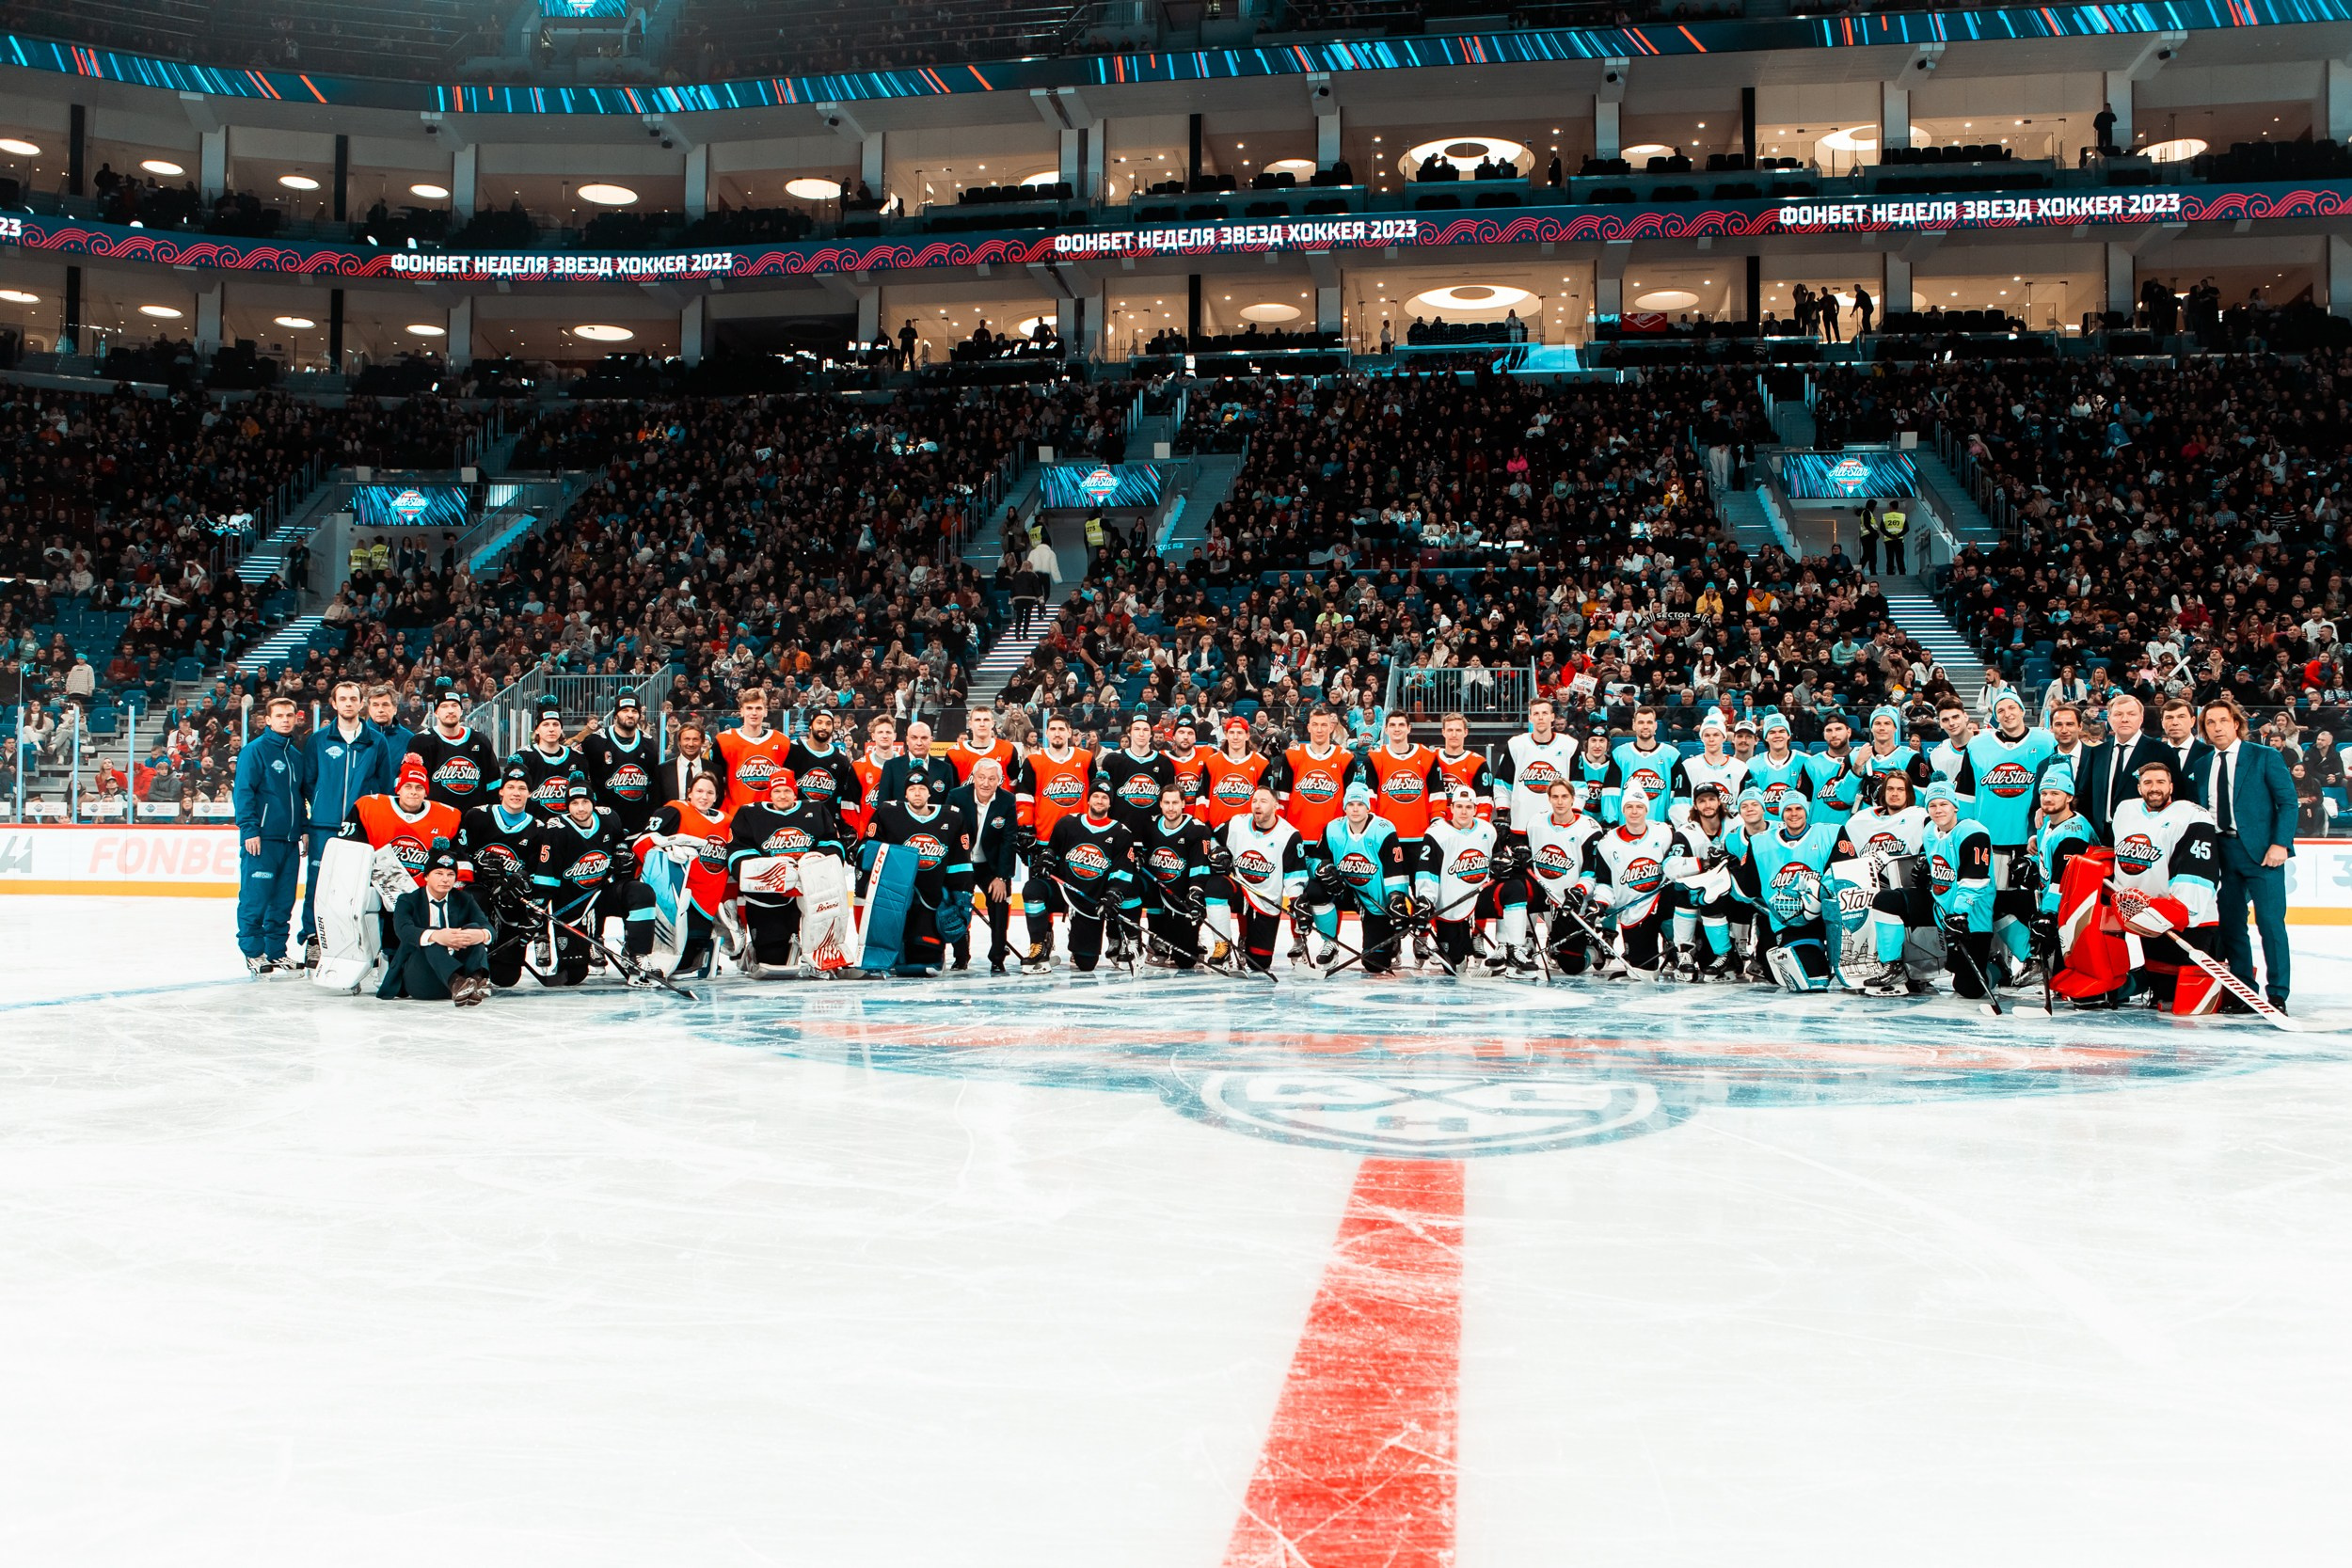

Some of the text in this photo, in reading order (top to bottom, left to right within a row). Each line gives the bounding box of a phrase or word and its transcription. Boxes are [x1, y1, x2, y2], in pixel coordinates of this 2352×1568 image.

[1779, 193, 2181, 226] ФОНБЕТ НЕДЕЛЯ ЗВЕЗД ХОККЕЯ 2023
[0, 216, 22, 237] 23
[1055, 219, 1418, 253] ФОНБЕТ НЕДЕЛЯ ЗВЕЗД ХОККЕЯ 2023
[390, 252, 733, 277] ФОНБЕТ НЕДЕЛЯ ЗВЕЗД ХОККЕЯ 2023
[866, 745, 904, 753] FOET
[434, 766, 481, 780] All-Star
[607, 773, 648, 787] All-Star
[1519, 768, 1562, 782] All-Star
[1980, 770, 2035, 784] All-Star
[796, 775, 836, 791] All-Star
[1043, 782, 1085, 795] All-Star
[1119, 782, 1161, 796] All-Star
[1213, 782, 1255, 796] All-Star
[1295, 778, 1339, 793] All-Star
[1381, 778, 1423, 792] All-Star
[762, 834, 813, 850] All-Star
[2189, 840, 2212, 861] 45
[87, 836, 236, 876] FONBE
[1065, 850, 1110, 869] All-Star
[1234, 856, 1275, 873] All-Star
[1534, 851, 1576, 869] All-Star
[1973, 847, 1990, 865] 14
[565, 859, 612, 879] All-Star
[871, 849, 886, 885] CCM
[1338, 860, 1378, 874] All-Star
[1449, 856, 1489, 874] All-Star
[1840, 891, 1874, 912] Star
[2201, 958, 2276, 1014] WARRIOR
